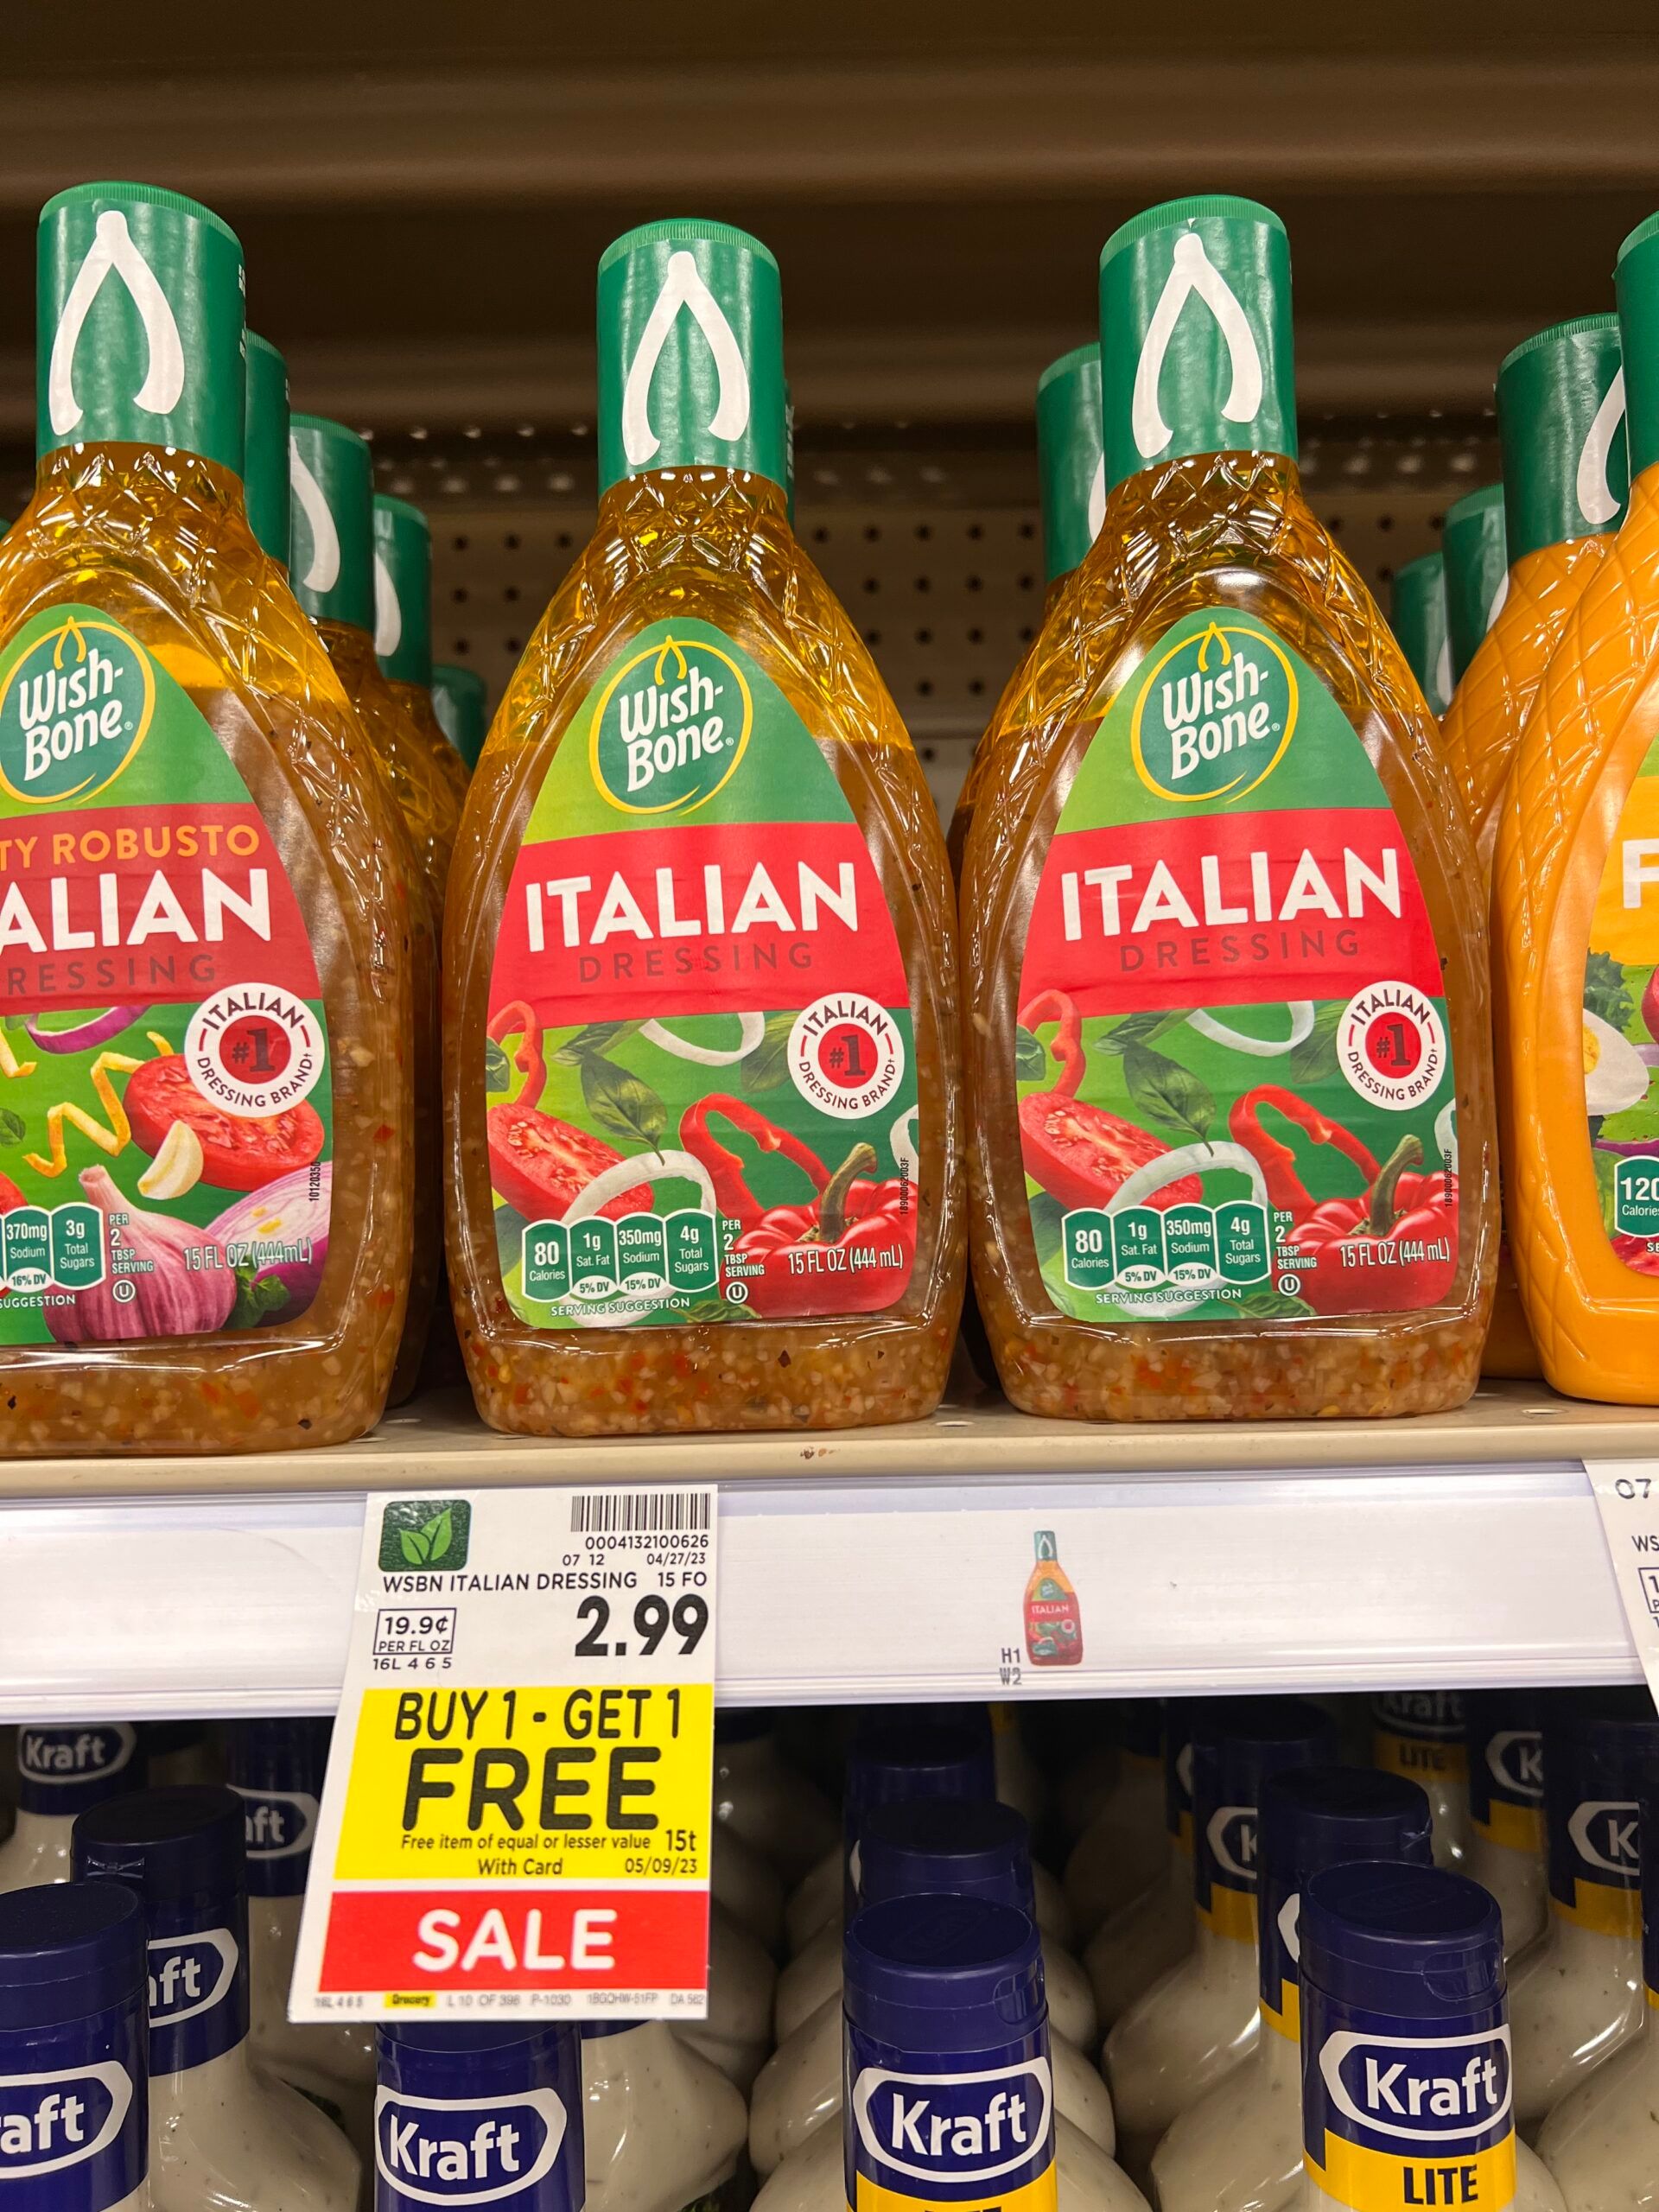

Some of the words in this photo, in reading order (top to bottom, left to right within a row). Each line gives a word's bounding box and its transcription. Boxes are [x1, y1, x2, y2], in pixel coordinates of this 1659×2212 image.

[19, 648, 124, 731] Wish-
[1161, 652, 1269, 730] Wish-
[620, 666, 724, 744] Wish-
[53, 824, 259, 865] ROBUSTO
[1061, 847, 1402, 941] ITALIAN
[0, 868, 271, 956] ALIAN
[525, 861, 858, 952] ITALIAN
[1120, 929, 1358, 972] DRESSING
[579, 942, 812, 983] DRESSING
[8, 954, 215, 995] RESSING
[202, 992, 304, 1031] ITALIAN
[1351, 988, 1431, 1026] ITALIAN
[803, 1001, 888, 1037] ITALIAN
[232, 1028, 275, 1072] #1
[1376, 1023, 1411, 1066] #1
[829, 1034, 866, 1077] #1
[197, 1057, 265, 1108] DRESSING
[1348, 1051, 1405, 1101] DRESSING
[799, 1061, 859, 1110] DRESSING
[309, 1161, 321, 1202] 10120350
[109, 1213, 129, 1225] PER
[722, 1220, 741, 1230] PER
[1230, 1217, 1250, 1235] 4g
[1274, 1211, 1293, 1223] PER
[6, 1224, 48, 1242] 370mg
[66, 1219, 85, 1238] 3g
[680, 1225, 699, 1244] 4g
[1128, 1222, 1147, 1240] 1g
[1166, 1219, 1211, 1237] 350mg
[1274, 1225, 1286, 1243] 2
[110, 1228, 121, 1247] 2
[583, 1233, 601, 1251] 1g
[619, 1230, 662, 1247] 350mg
[723, 1233, 734, 1251] 2
[1075, 1230, 1103, 1253] 80
[1230, 1239, 1255, 1250] Total
[10, 1247, 45, 1259] Sodium
[65, 1243, 88, 1255] Total
[111, 1249, 136, 1261] TBSP
[183, 1248, 200, 1270] 15
[204, 1245, 222, 1268] FL
[226, 1243, 249, 1267] OZ
[534, 1241, 559, 1266] 80
[623, 1251, 660, 1264] Sodium
[679, 1248, 702, 1259] Total
[1121, 1245, 1141, 1255] Sat.
[1142, 1243, 1158, 1255] Fat
[1171, 1243, 1210, 1254] Sodium
[1276, 1246, 1300, 1257] TBSP
[1340, 1245, 1356, 1268] 15
[1358, 1243, 1375, 1266] FL
[1378, 1242, 1396, 1265] OZ
[1399, 1240, 1425, 1266] (444
[1427, 1237, 1450, 1262] mL)
[60, 1256, 95, 1270] Sugars
[111, 1260, 154, 1274] SERVING
[576, 1256, 594, 1267] Sat.
[596, 1255, 610, 1266] Fat
[675, 1261, 709, 1274] Sugars
[725, 1253, 748, 1265] TBSP
[789, 1252, 804, 1274] 15
[807, 1250, 824, 1273] FL
[828, 1249, 848, 1272] OZ
[849, 1247, 877, 1273] (444
[879, 1244, 903, 1269] mL)
[1071, 1257, 1109, 1268] Calories
[1225, 1253, 1261, 1266] Sugars
[1277, 1257, 1318, 1270] SERVING
[530, 1269, 566, 1281] Calories
[725, 1264, 766, 1277] SERVING
[1125, 1272, 1141, 1282] 5%
[1143, 1271, 1157, 1281] DV
[1173, 1269, 1196, 1281] 15%
[1198, 1268, 1211, 1279] DV
[12, 1274, 32, 1286] 16%
[34, 1274, 46, 1284] DV
[580, 1283, 594, 1294] 5%
[596, 1281, 609, 1293] DV
[625, 1279, 646, 1290] 15%
[648, 1277, 661, 1288] DV
[1096, 1292, 1153, 1305] SERVING
[1156, 1288, 1242, 1302] SUGGESTION
[551, 1302, 606, 1316] SERVING
[608, 1297, 690, 1313] SUGGESTION
[1615, 1478, 1651, 1499] 07
[585, 1535, 709, 1549] 0004132100626
[563, 1554, 580, 1566] 07
[589, 1554, 605, 1566] 12
[646, 1552, 706, 1567] 04/27/23
[383, 1575, 442, 1592] WSBN
[450, 1573, 529, 1591] ITALIAN
[537, 1572, 637, 1589] DRESSING
[658, 1573, 675, 1587] 15
[682, 1572, 707, 1586] FO
[385, 1616, 448, 1635] 19.9¢
[575, 1593, 709, 1656] 2.99
[378, 1640, 404, 1652] PER
[409, 1640, 425, 1651] FL
[429, 1639, 450, 1651] OZ
[373, 1657, 401, 1670] 16L
[408, 1658, 418, 1669] 4
[425, 1657, 435, 1669] 6
[442, 1656, 452, 1669] 5
[1001, 1648, 1021, 1664] H1
[1000, 1668, 1022, 1685] W2
[394, 1689, 489, 1740] BUY
[503, 1689, 517, 1740] 1
[563, 1688, 652, 1739] GET
[666, 1688, 681, 1738] 1
[25, 1733, 106, 1770] Kraft
[402, 1746, 662, 1832] FREE
[401, 1834, 435, 1849] Free
[440, 1834, 473, 1849] item
[478, 1834, 493, 1849] of
[498, 1834, 539, 1852] equal
[543, 1836, 559, 1849] or
[563, 1833, 607, 1849] lesser
[612, 1833, 651, 1849] value
[666, 1828, 696, 1852] 15t
[478, 1858, 517, 1875] With
[524, 1858, 563, 1875] Card
[625, 1857, 697, 1875] 05/09/23
[412, 1909, 617, 1972] SALE
[1365, 2056, 1497, 2116] Kraft
[892, 2092, 1027, 2156] Kraft
[391, 2114, 519, 2181] Kraft
[1403, 2164, 1478, 2205] LITE
